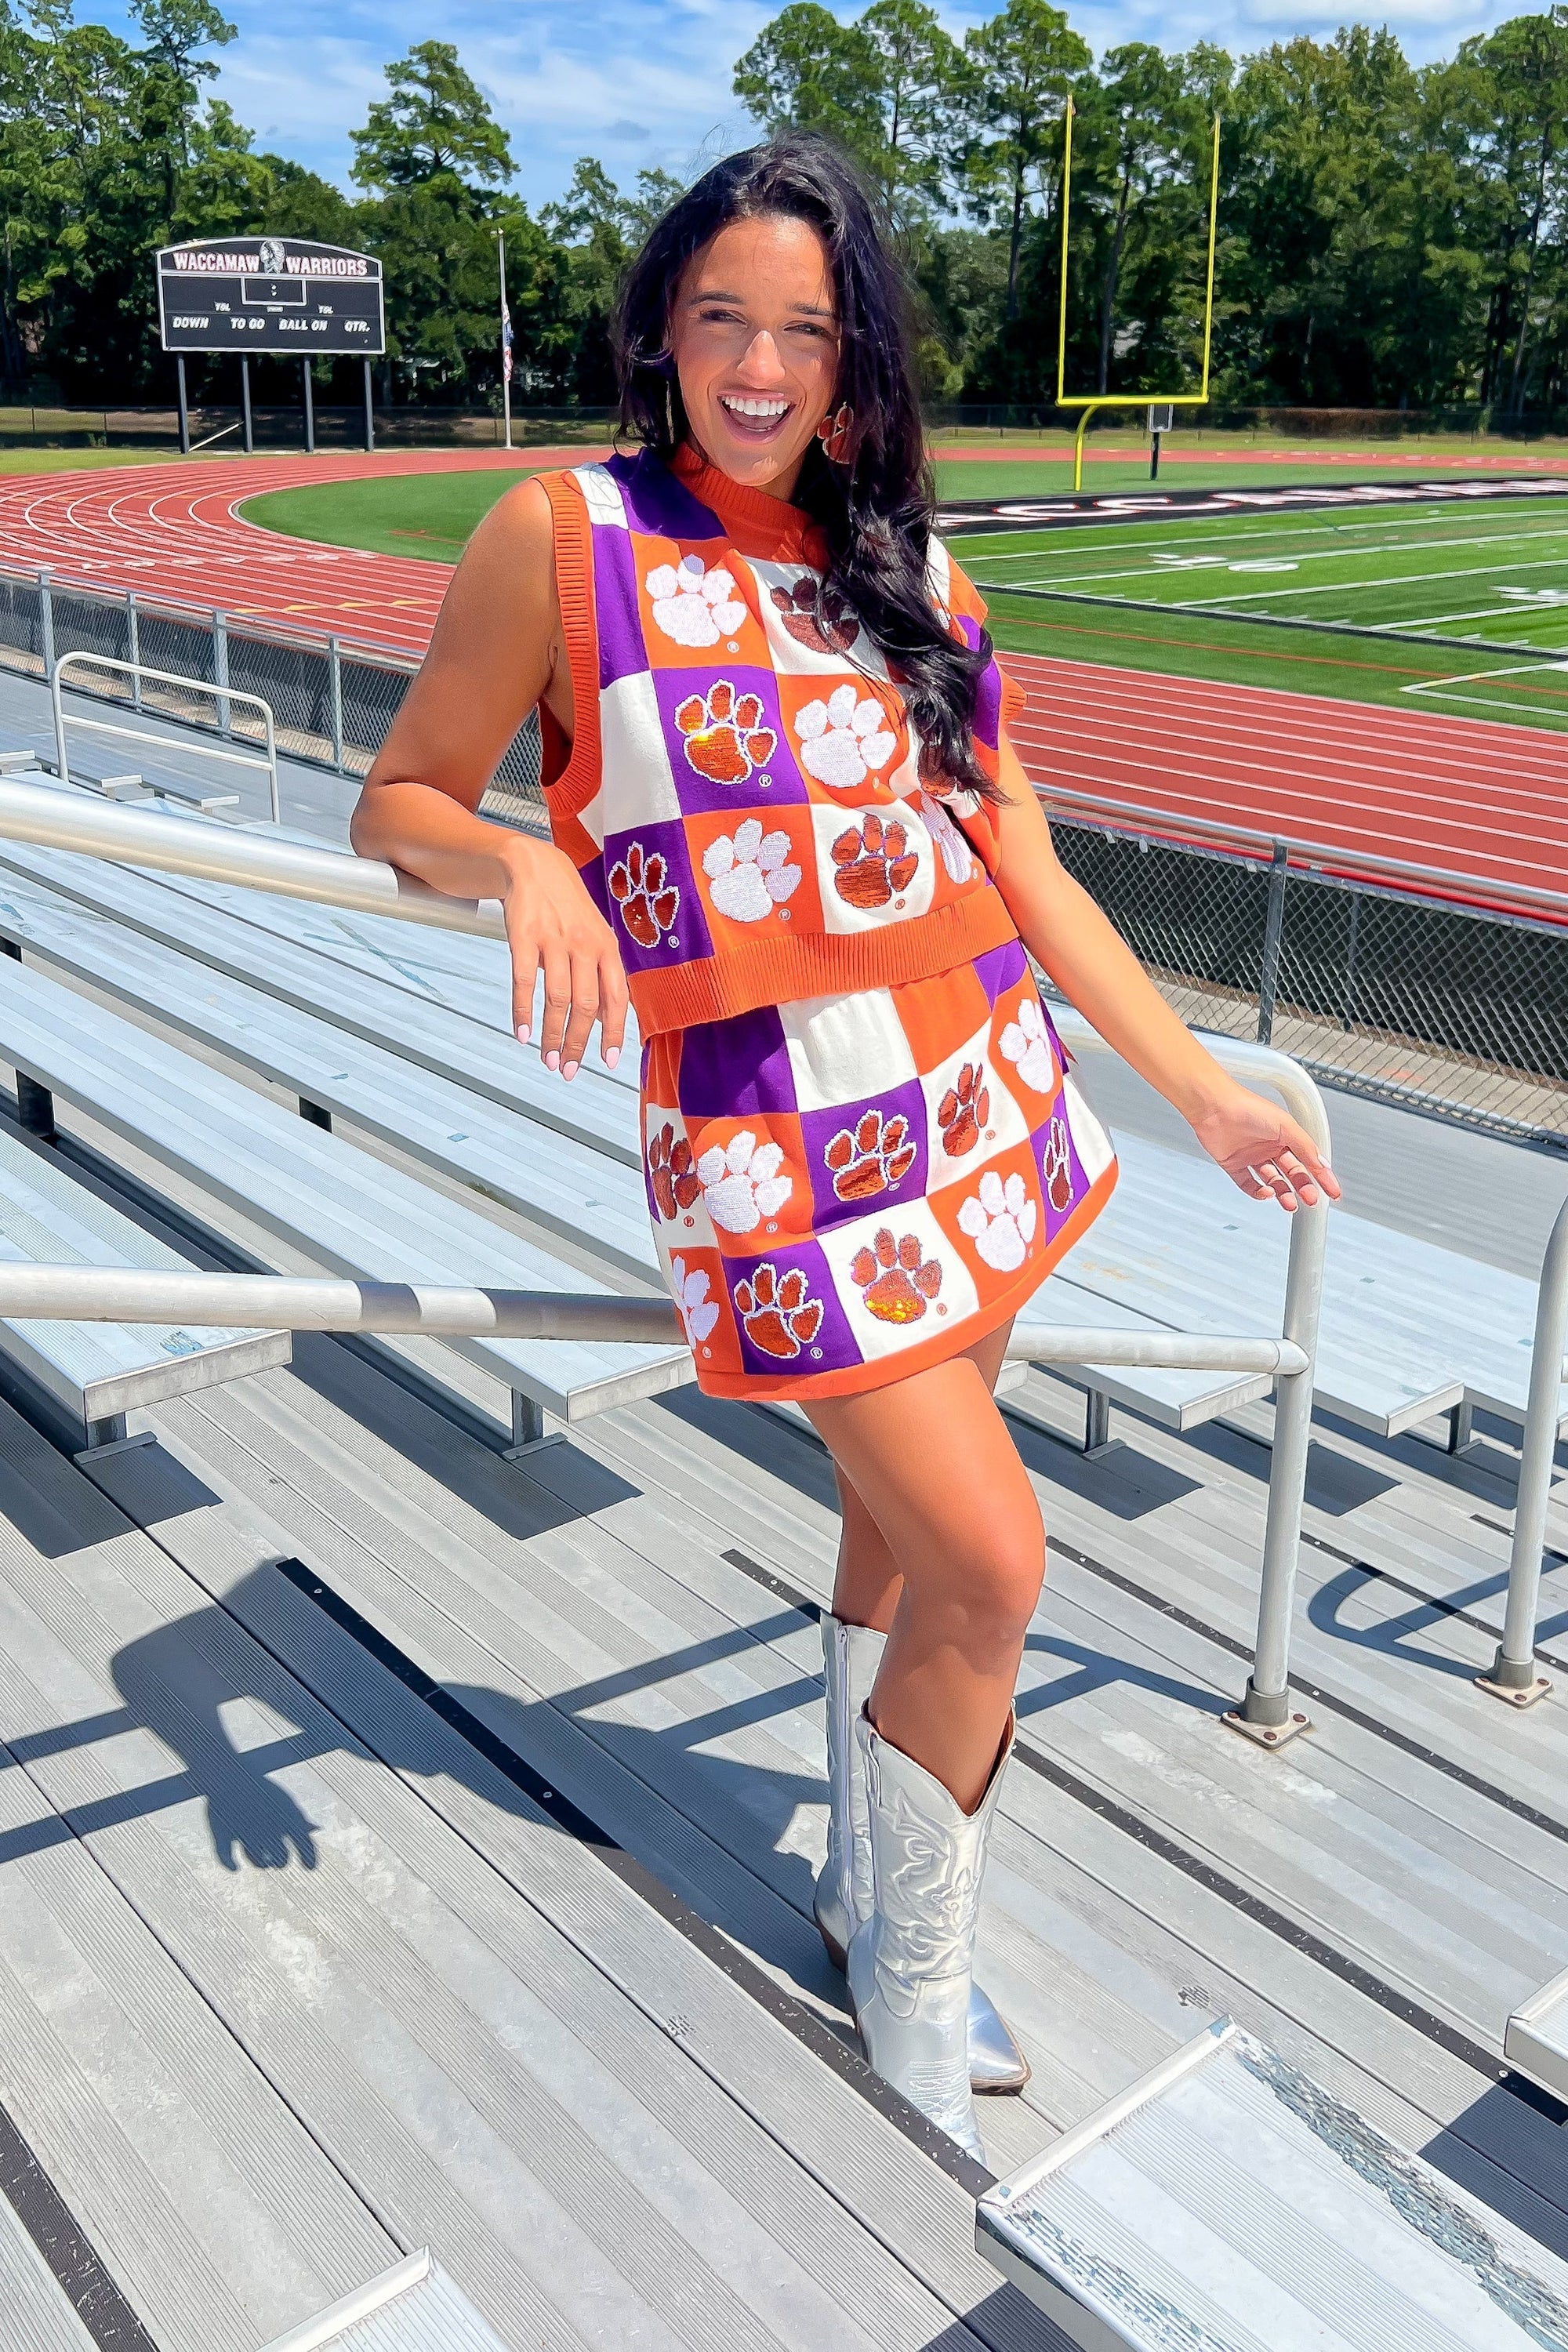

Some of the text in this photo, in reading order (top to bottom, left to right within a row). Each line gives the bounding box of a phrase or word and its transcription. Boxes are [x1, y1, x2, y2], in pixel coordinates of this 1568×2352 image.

[172, 252, 367, 276] WACCAMAW WARRIORS
[172, 316, 209, 328] DOWN
[230, 317, 265, 329] TO GO
[278, 318, 328, 331] BALL ON
